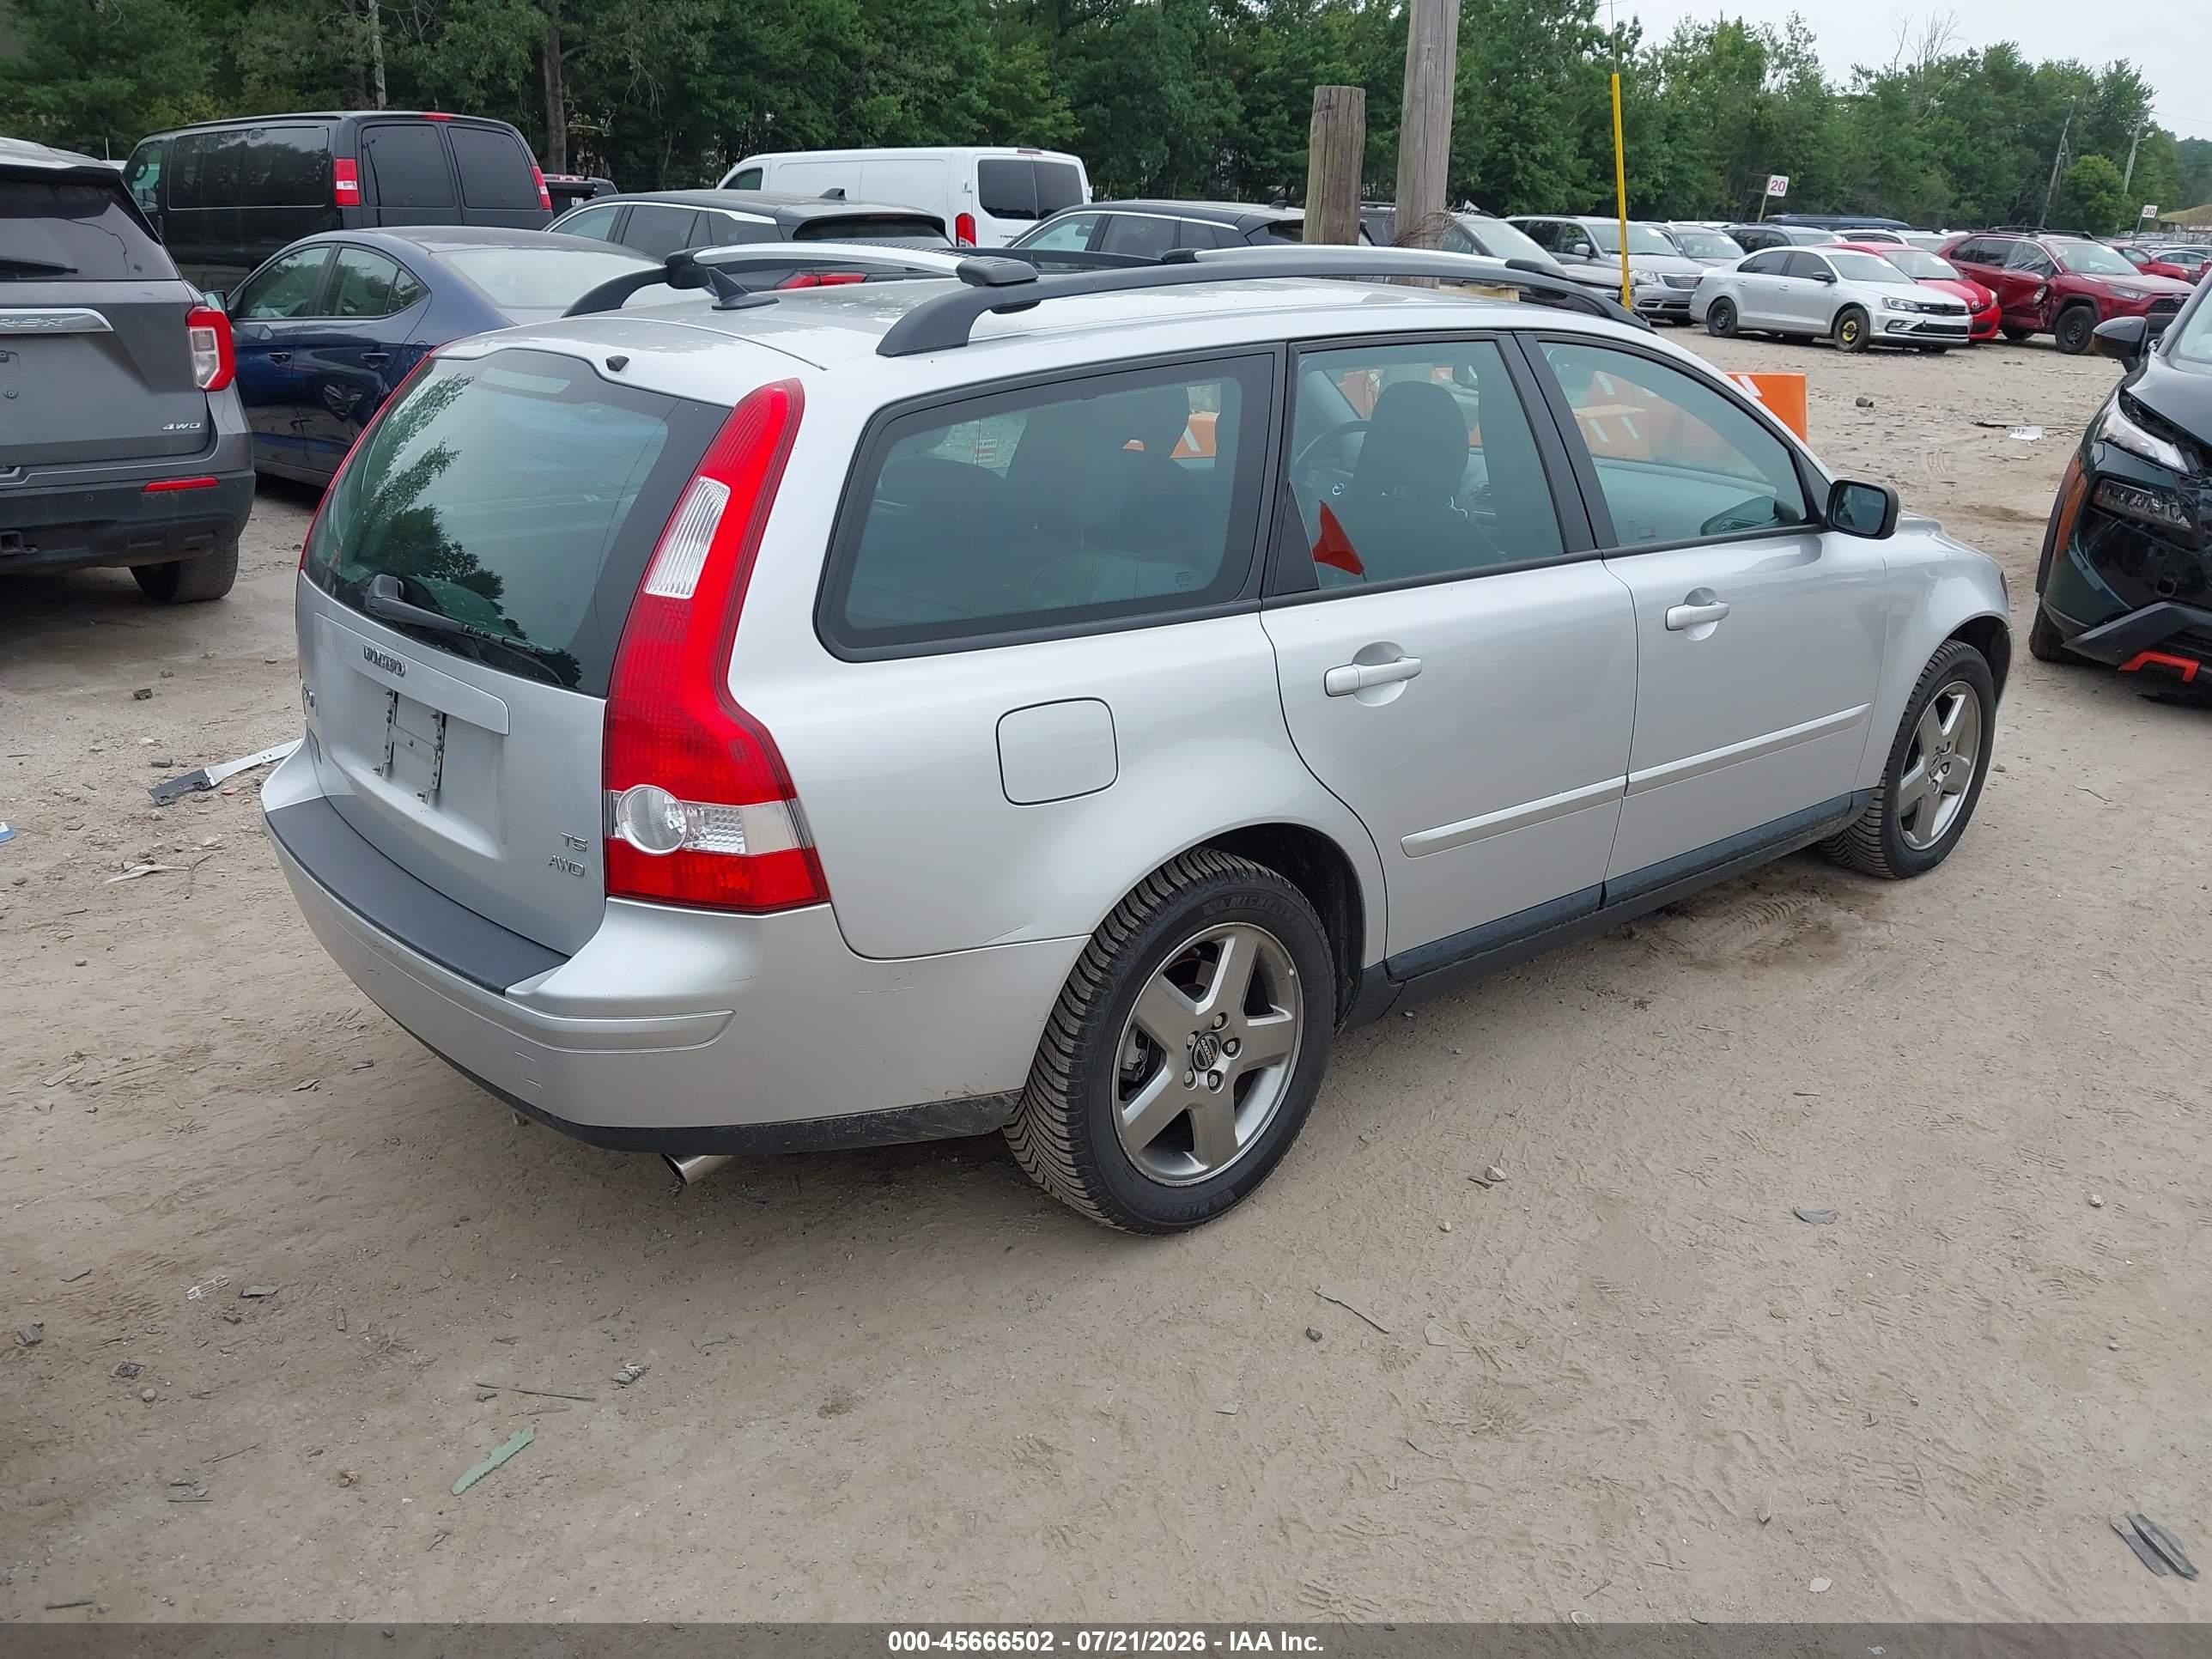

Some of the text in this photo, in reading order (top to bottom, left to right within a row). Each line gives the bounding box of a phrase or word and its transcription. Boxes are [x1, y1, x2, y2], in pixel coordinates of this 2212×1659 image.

[1770, 179, 1787, 192] 20
[2143, 207, 2155, 216] 30
[560, 831, 587, 852] T5
[548, 854, 586, 877] AWD
[1200, 1039, 1214, 1066] VOLVO
